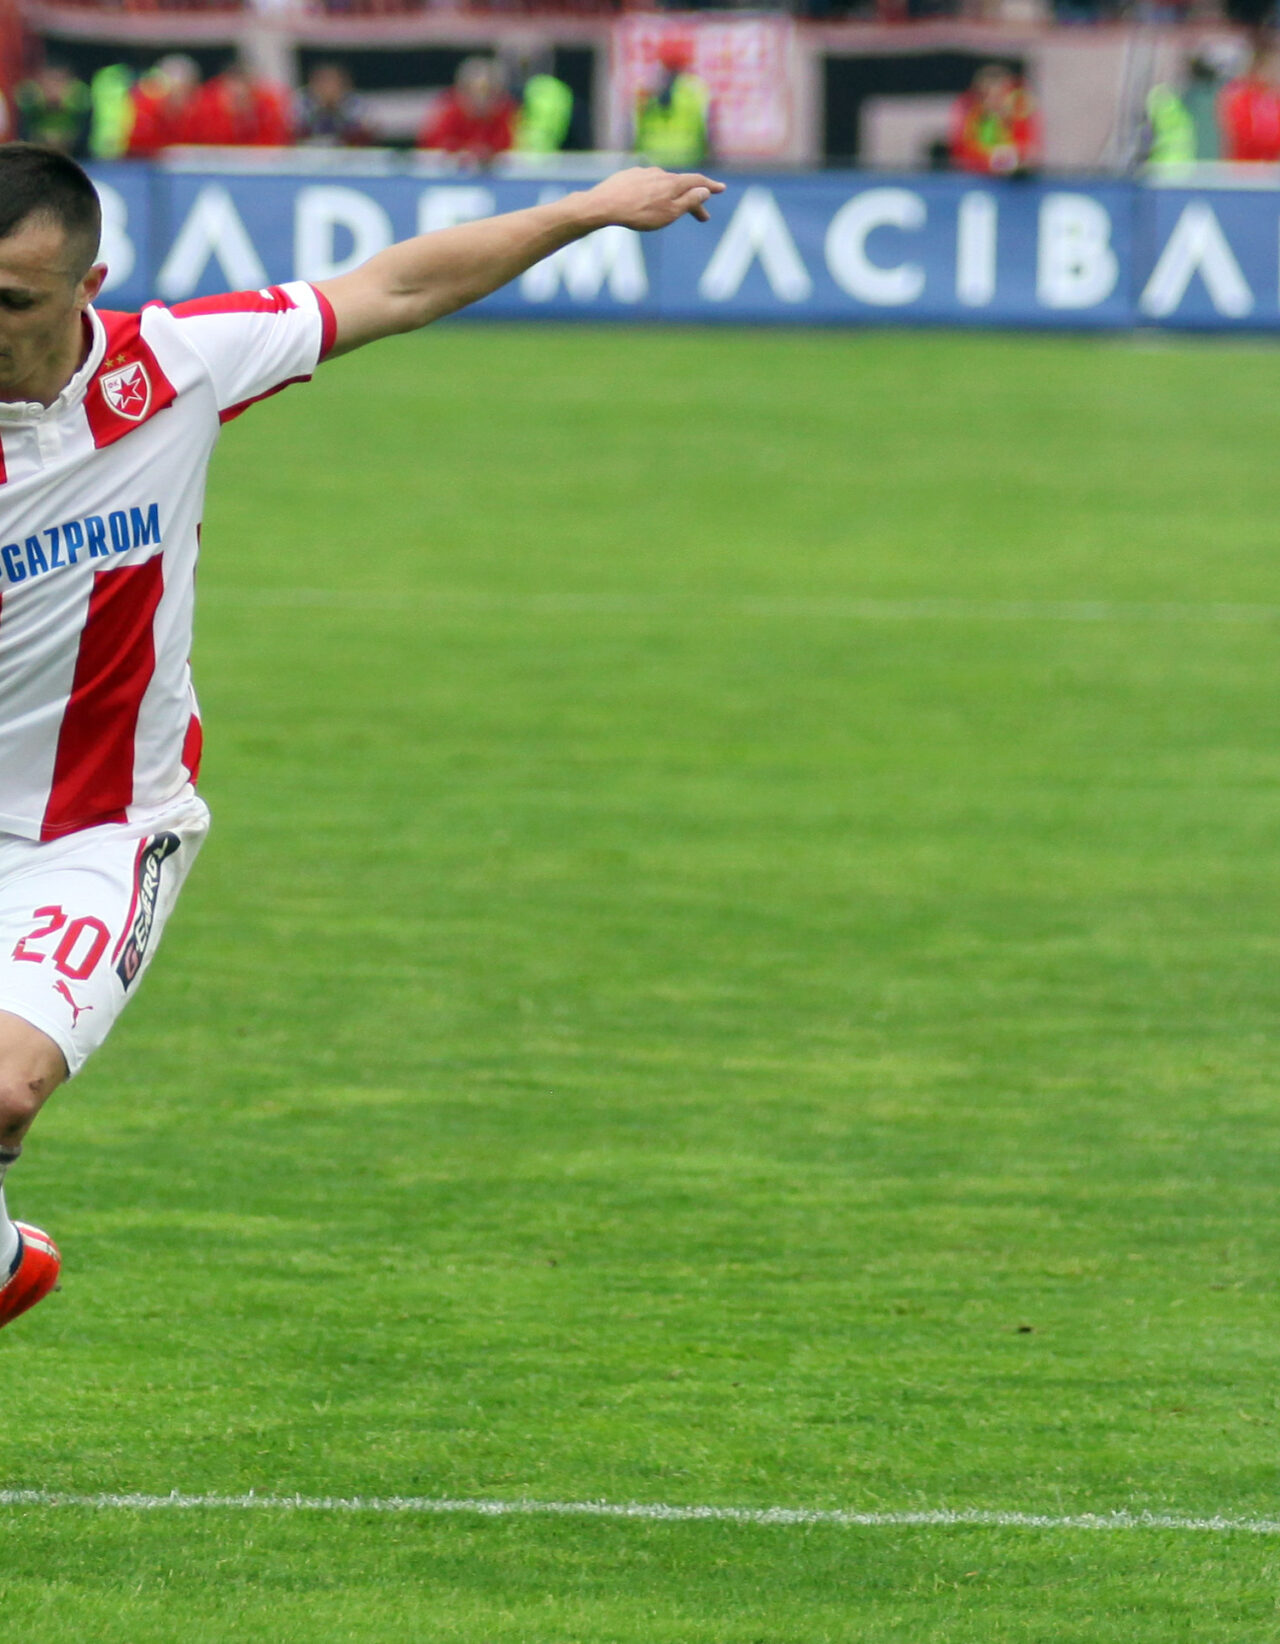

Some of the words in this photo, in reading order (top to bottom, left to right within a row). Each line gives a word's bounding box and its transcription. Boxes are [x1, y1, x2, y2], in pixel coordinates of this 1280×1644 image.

[698, 185, 1280, 319] ACIBA
[1, 503, 161, 583] GAZPROM
[11, 904, 111, 980] 20
